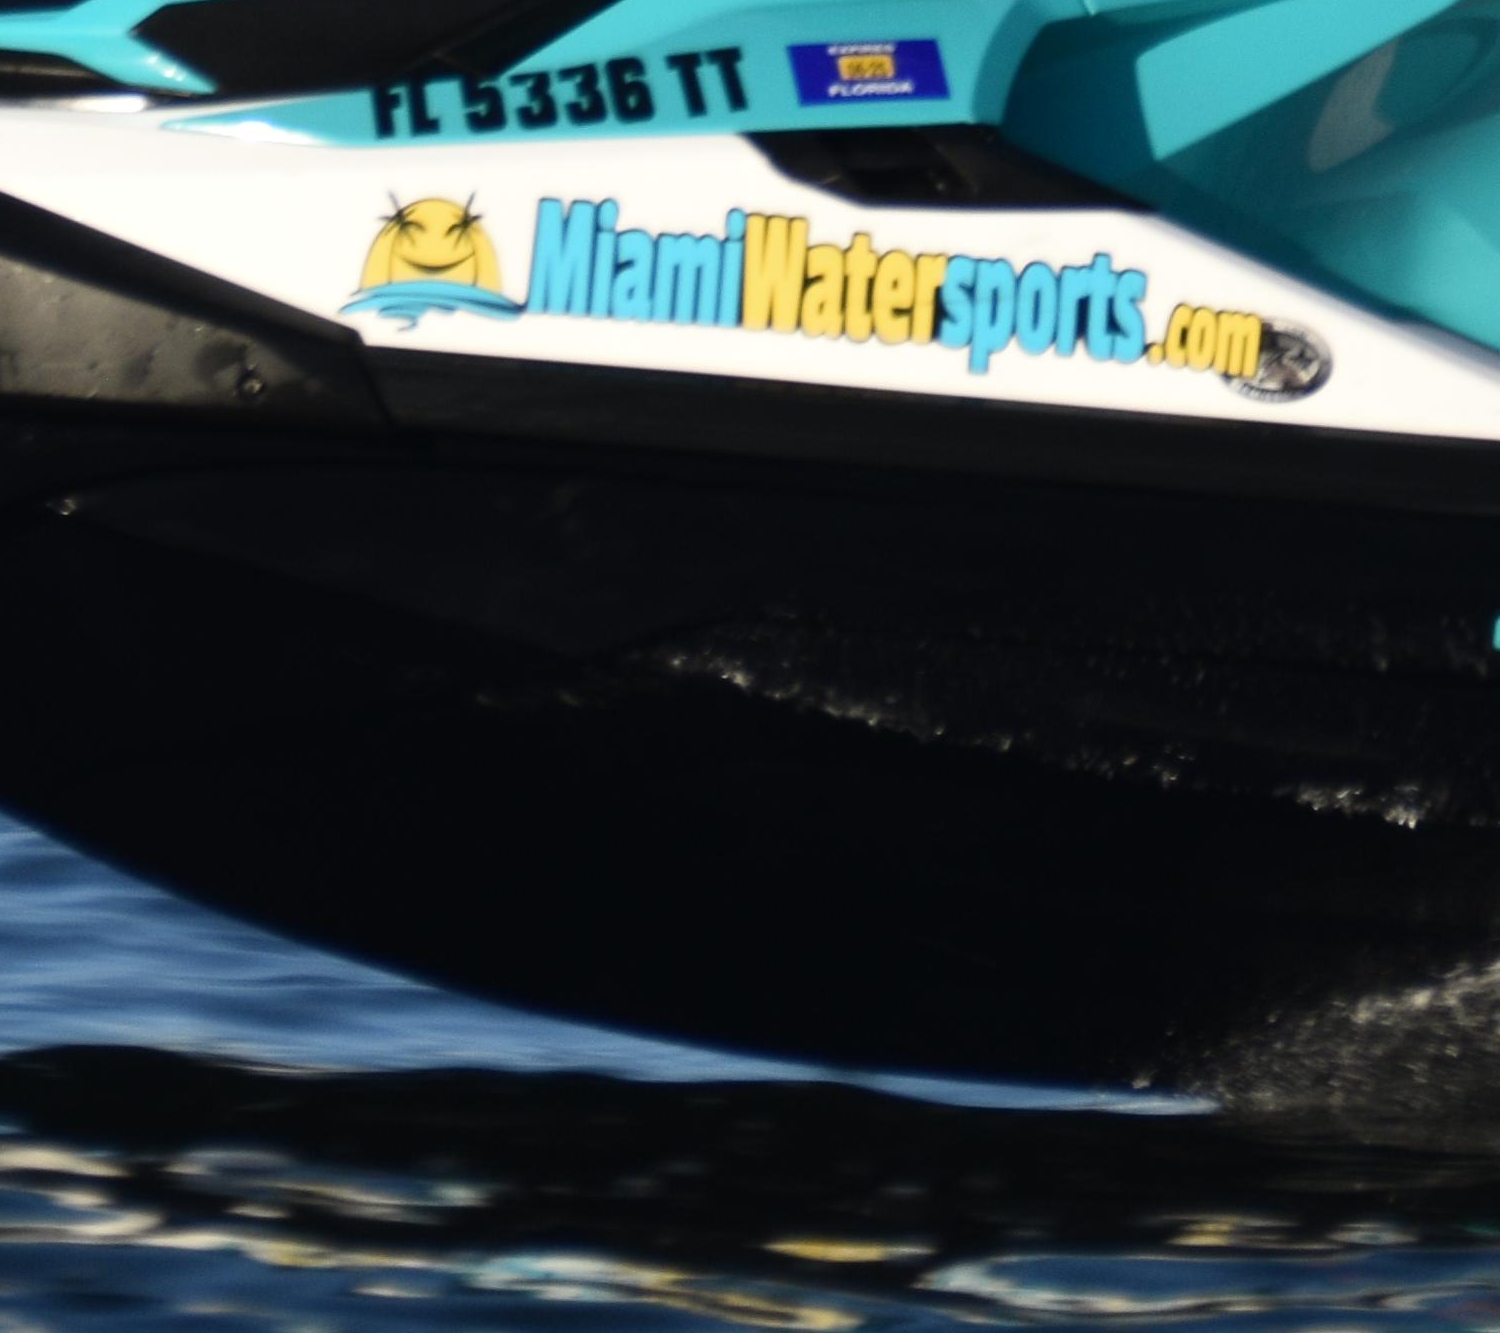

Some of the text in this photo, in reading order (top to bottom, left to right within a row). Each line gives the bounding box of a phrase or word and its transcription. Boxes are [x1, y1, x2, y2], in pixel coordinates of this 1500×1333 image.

[371, 45, 750, 139] FL 5336 TT
[827, 80, 915, 98] FLORIDA
